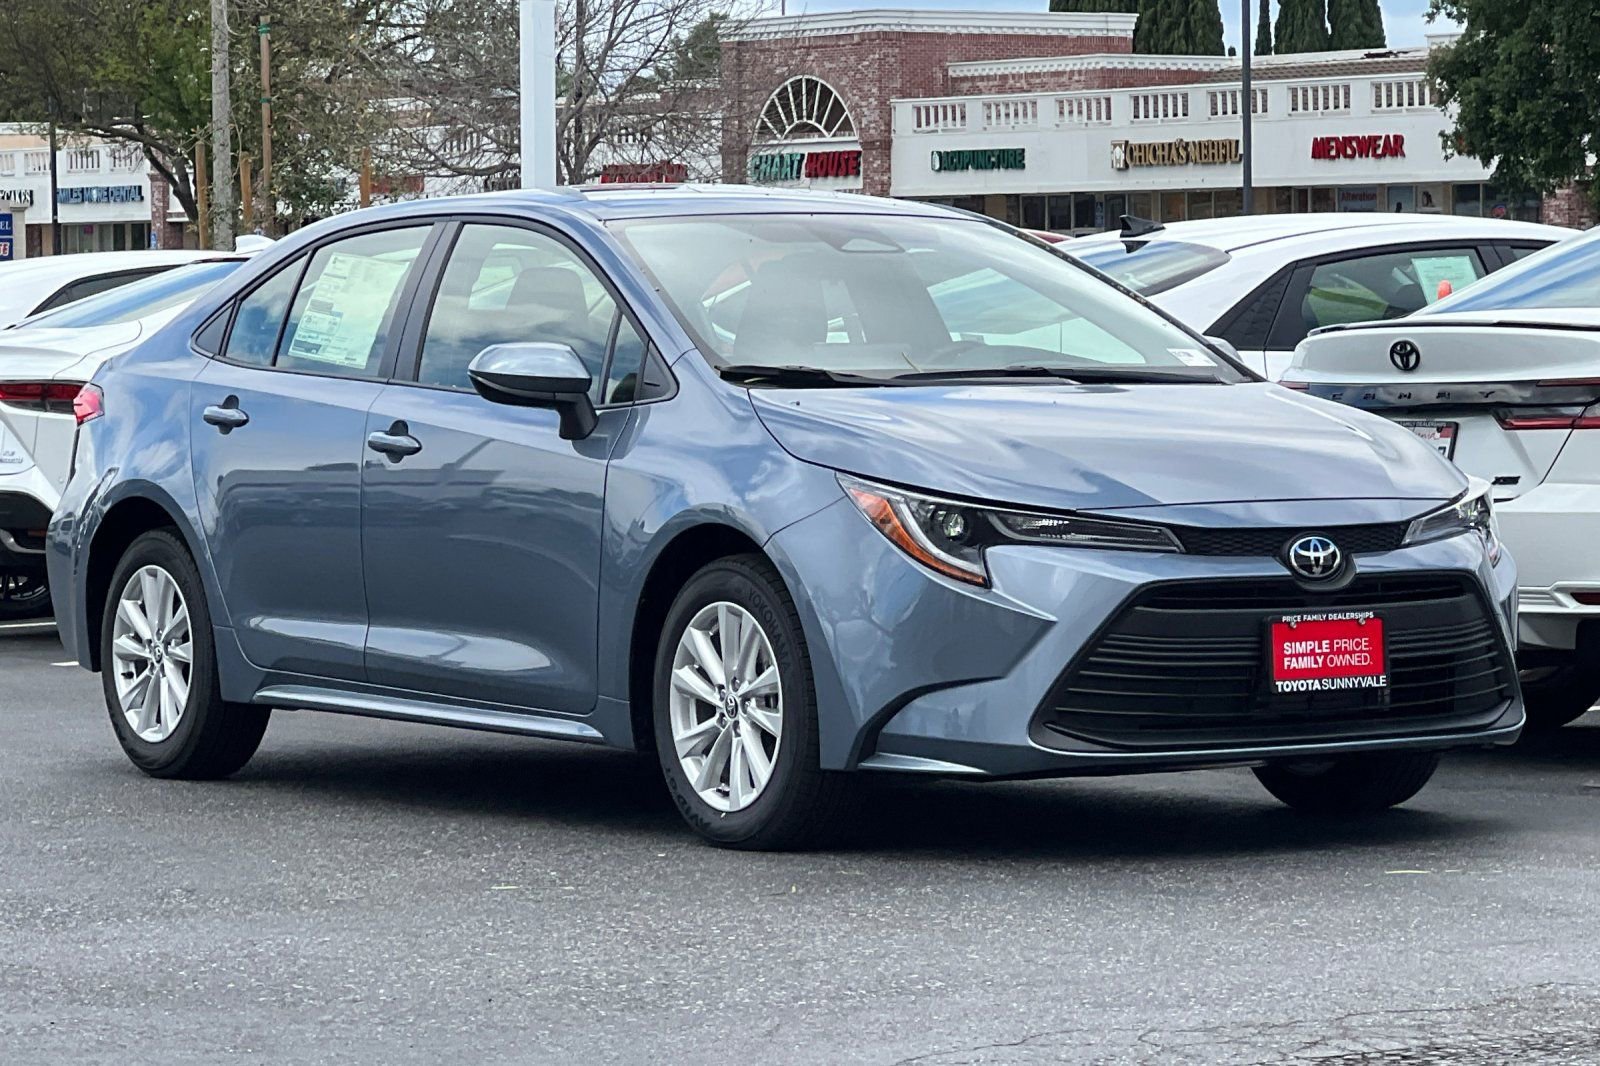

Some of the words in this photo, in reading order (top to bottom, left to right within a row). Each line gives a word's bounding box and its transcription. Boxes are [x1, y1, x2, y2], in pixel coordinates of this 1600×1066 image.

[1311, 134, 1406, 160] MENSWEAR
[751, 153, 804, 180] CHAAT
[805, 149, 861, 178] HOUSE
[942, 148, 1025, 171] ACUPUNCTURE
[108, 185, 143, 202] DENTAL
[1328, 611, 1374, 620] DEALERSHIPS
[748, 587, 791, 674] YOKOHAMA
[1283, 640, 1330, 655] SIMPLE
[1333, 637, 1373, 652] PRICE.
[1283, 655, 1324, 670] FAMILY
[1326, 652, 1373, 667] OWNED.
